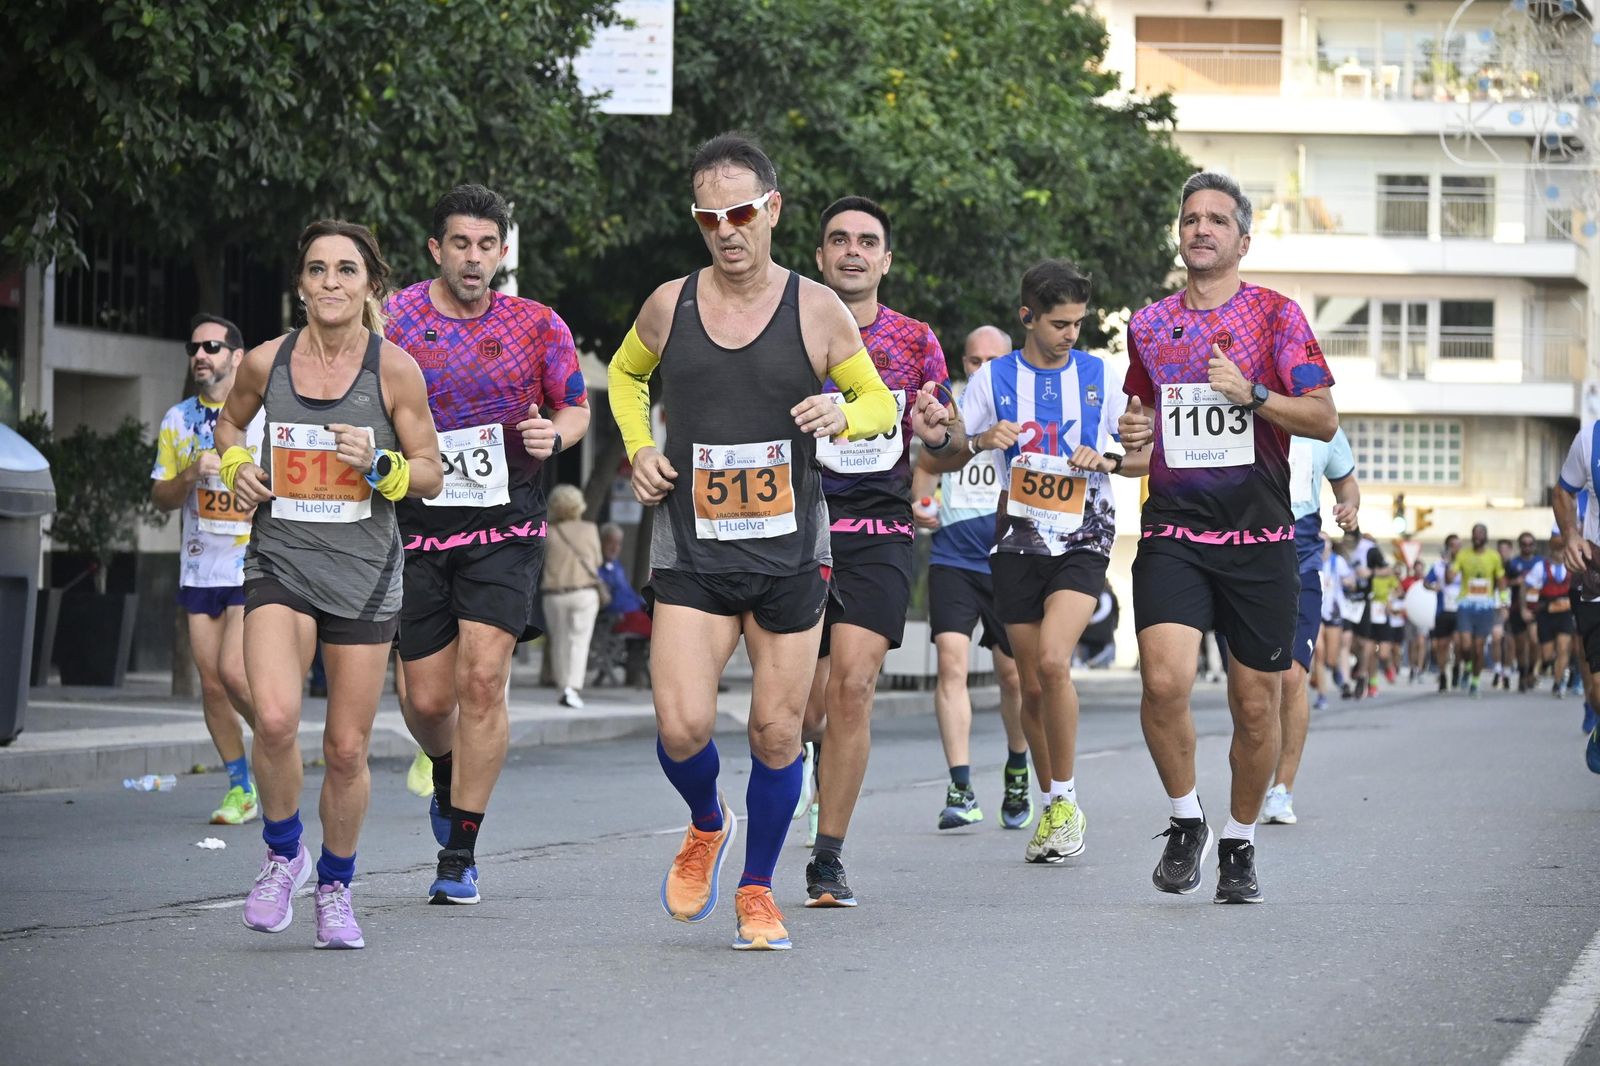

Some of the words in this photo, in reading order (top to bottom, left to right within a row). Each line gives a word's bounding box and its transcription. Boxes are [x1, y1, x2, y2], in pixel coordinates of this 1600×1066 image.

[1168, 406, 1248, 436] 1103
[276, 426, 295, 442] 21K
[1020, 419, 1077, 458] 21K
[840, 455, 877, 467] Huelva
[1185, 450, 1225, 461] Huelva
[286, 450, 358, 487] 512
[706, 468, 778, 505] 513
[1021, 470, 1074, 501] 580
[445, 489, 484, 500] Huelva
[295, 500, 341, 513] Huelva
[1025, 506, 1058, 520] Huelva
[715, 511, 740, 519] ARAGON
[740, 510, 771, 518] RODRIGUEZ
[718, 519, 765, 532] Huelva
